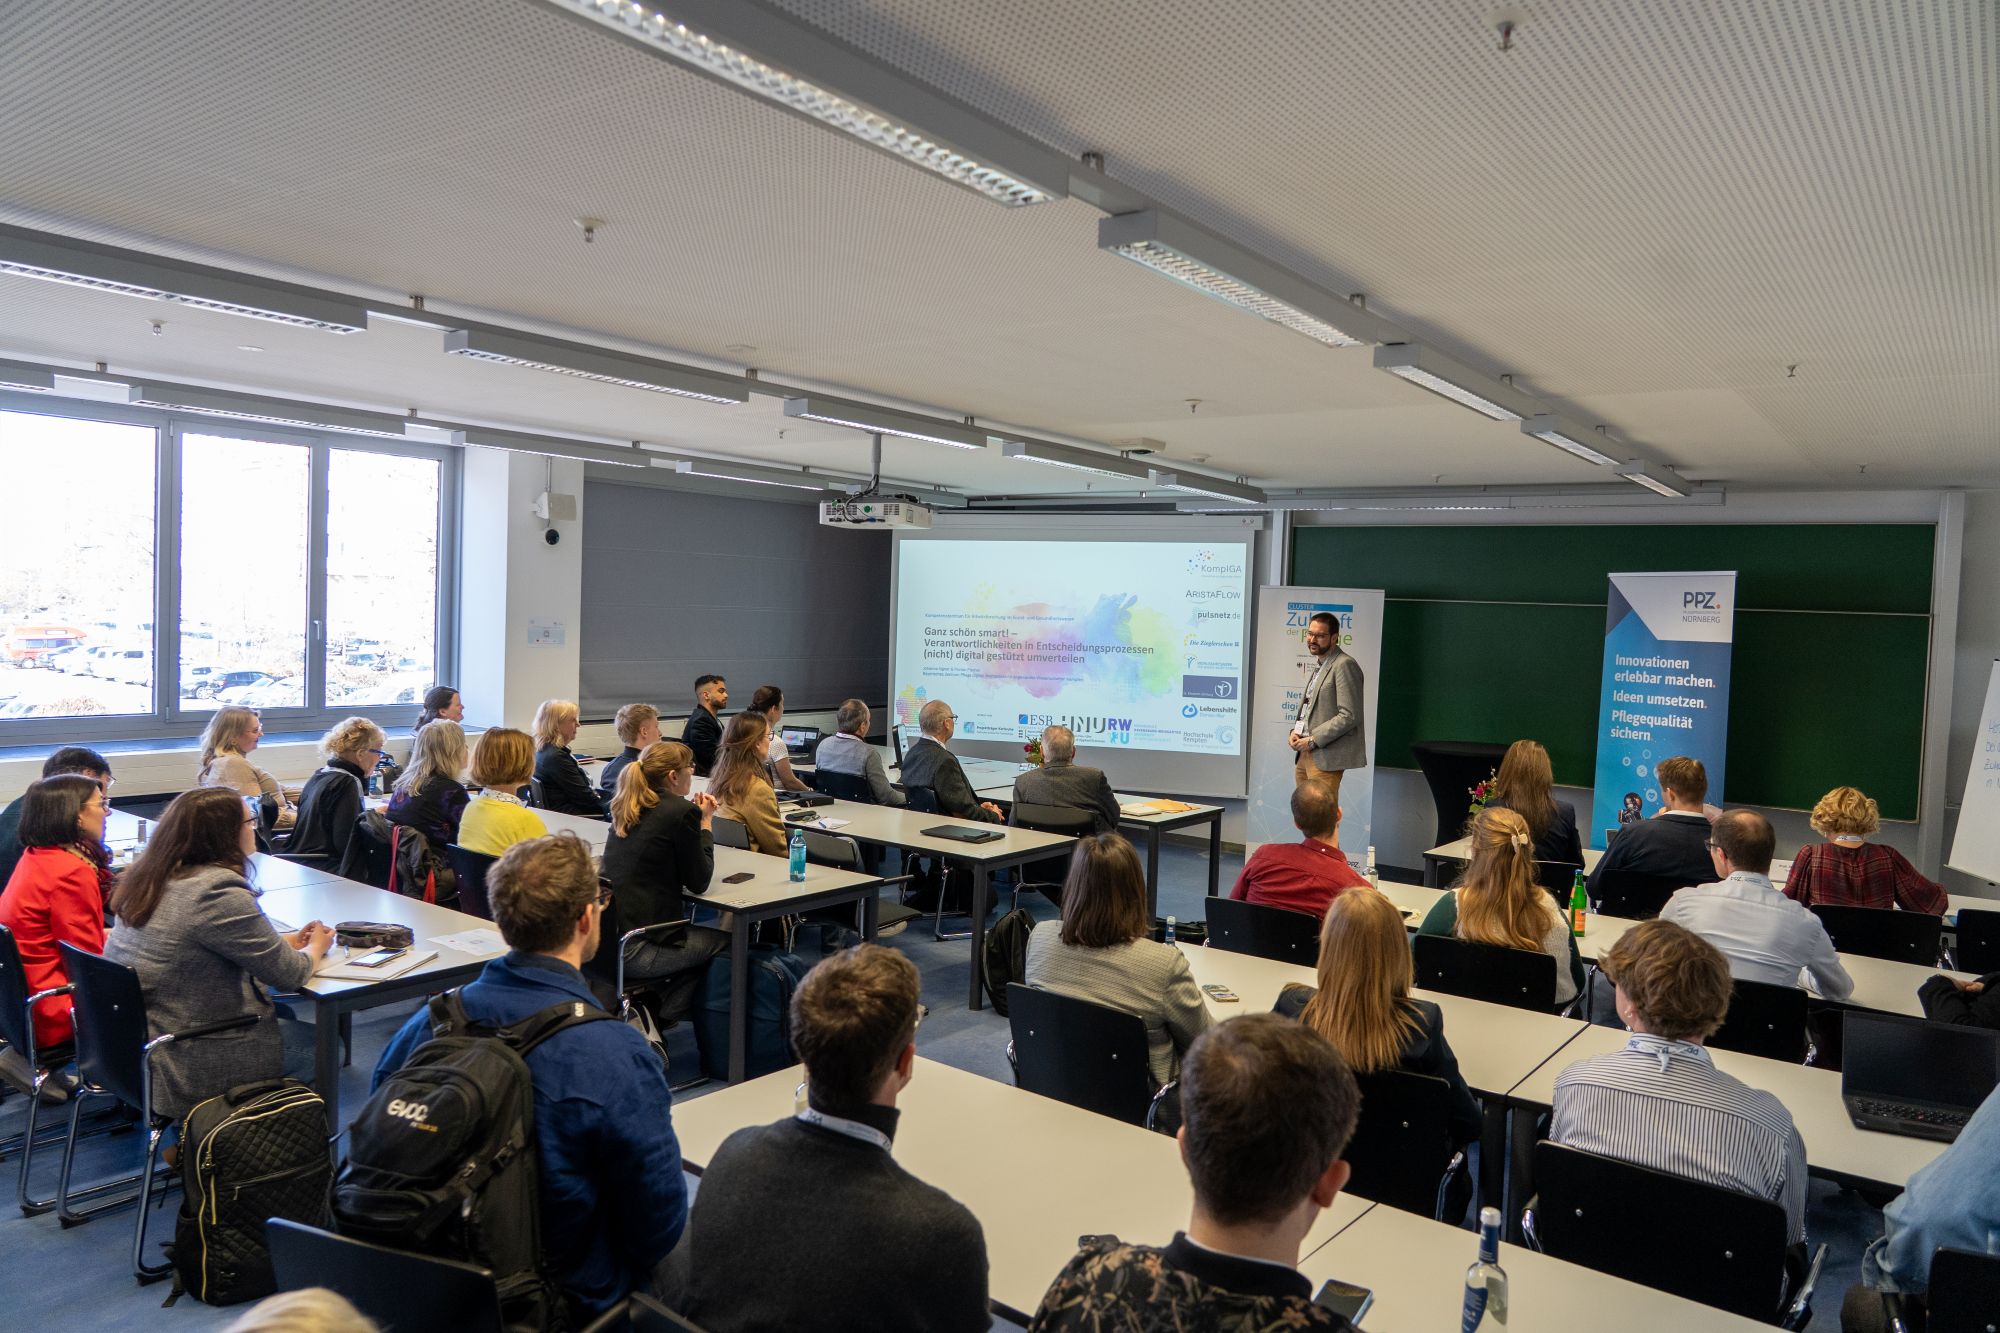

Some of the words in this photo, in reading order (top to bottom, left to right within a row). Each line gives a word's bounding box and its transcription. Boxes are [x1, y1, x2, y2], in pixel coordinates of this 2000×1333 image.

[924, 627, 947, 636] Ganz
[949, 627, 976, 637] schön
[978, 629, 1009, 637] smart!
[924, 639, 1022, 649] Verantwortlichkeiten
[1024, 641, 1034, 650] in
[1036, 642, 1154, 654] Entscheidungsprozessen
[923, 649, 953, 660] (nicht)
[955, 650, 984, 661] digital
[986, 651, 1025, 662] gestützt
[1027, 653, 1085, 664] umverteilen
[1615, 654, 1690, 669] Innovationen
[1614, 670, 1662, 684] erlebbar
[1664, 674, 1716, 688] machen.
[1613, 690, 1643, 704] Ideen
[1647, 695, 1708, 709] umsetzen.
[1611, 710, 1693, 729] Pflegequalität
